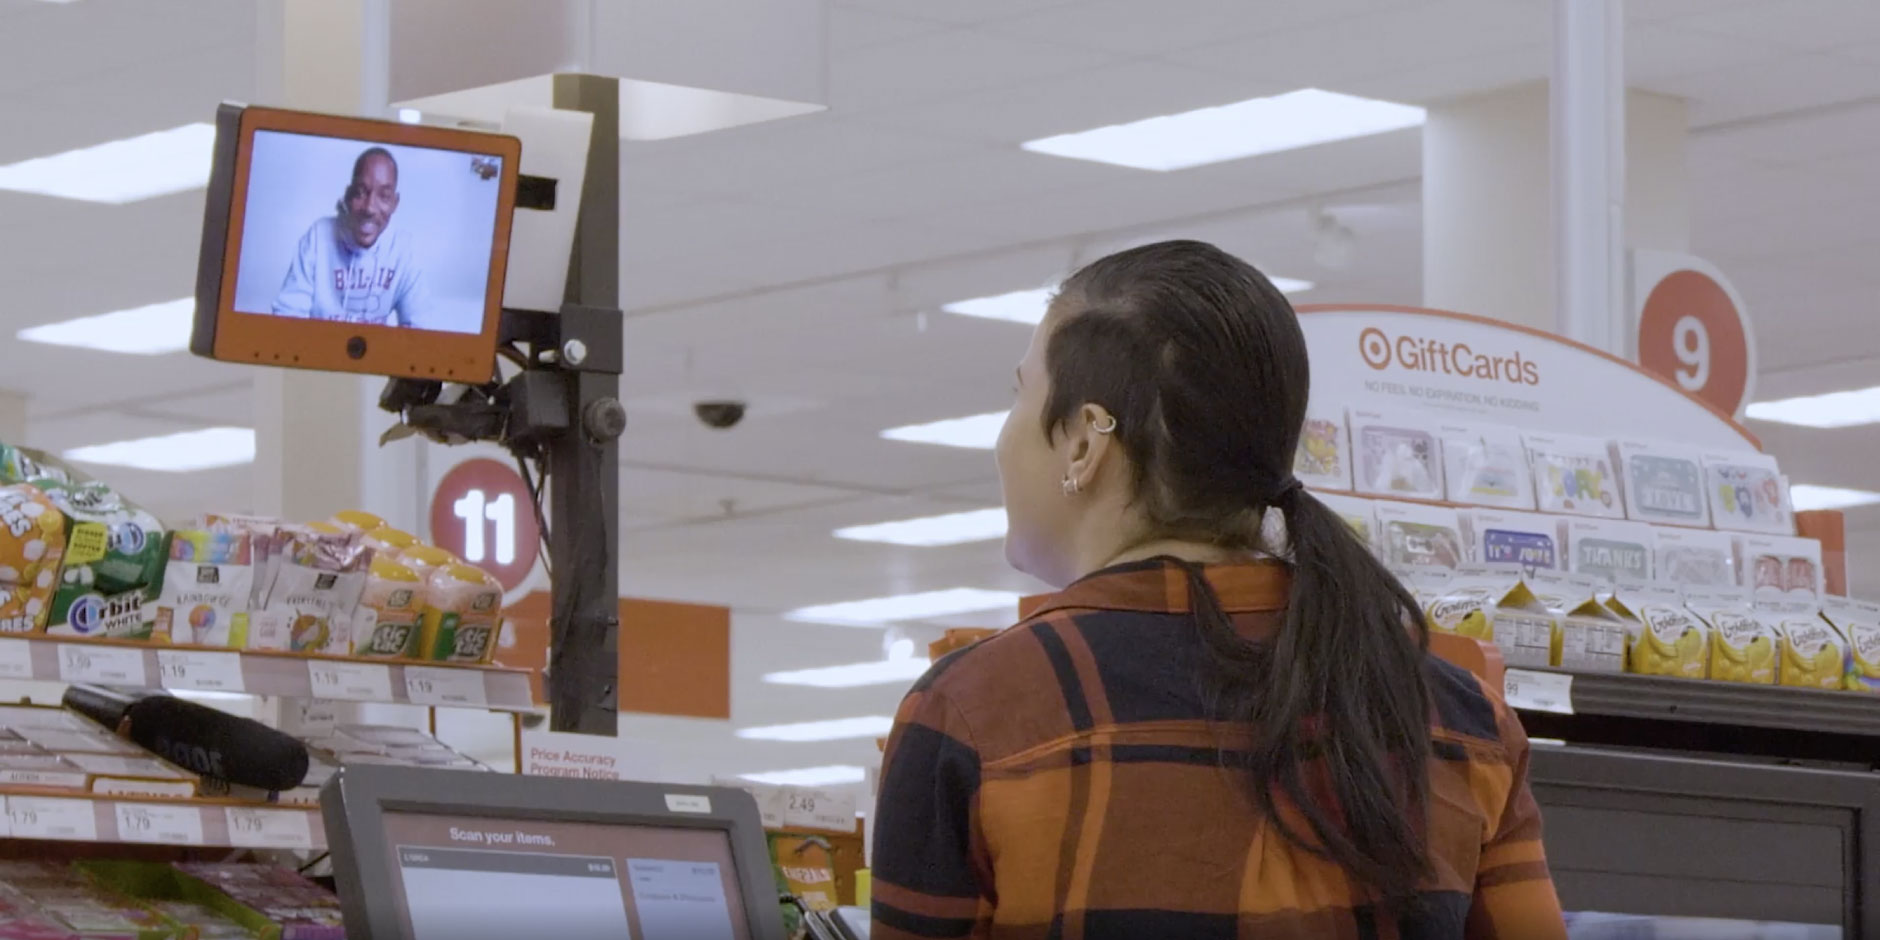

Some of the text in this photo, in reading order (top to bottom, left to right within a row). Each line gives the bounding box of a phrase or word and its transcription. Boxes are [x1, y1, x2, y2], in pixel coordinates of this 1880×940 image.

[1396, 335, 1540, 386] GiftCards
[1672, 315, 1710, 391] 9
[1364, 380, 1379, 392] NO
[1408, 386, 1423, 397] NO
[1483, 396, 1498, 407] NO
[453, 489, 515, 565] 11
[1583, 546, 1641, 570] THANKS
[67, 593, 142, 634] Orbit
[105, 612, 142, 630] WHITE
[160, 664, 186, 679] 1.19
[314, 672, 338, 685] 1.19
[408, 680, 433, 694] 1.19
[530, 747, 617, 768] Price Accuracy
[530, 763, 619, 780] Program Notice
[788, 796, 815, 812] 2.49
[125, 816, 150, 831] 1.79
[233, 815, 263, 831] 1.79
[449, 827, 483, 843] Scan
[485, 829, 513, 845] your
